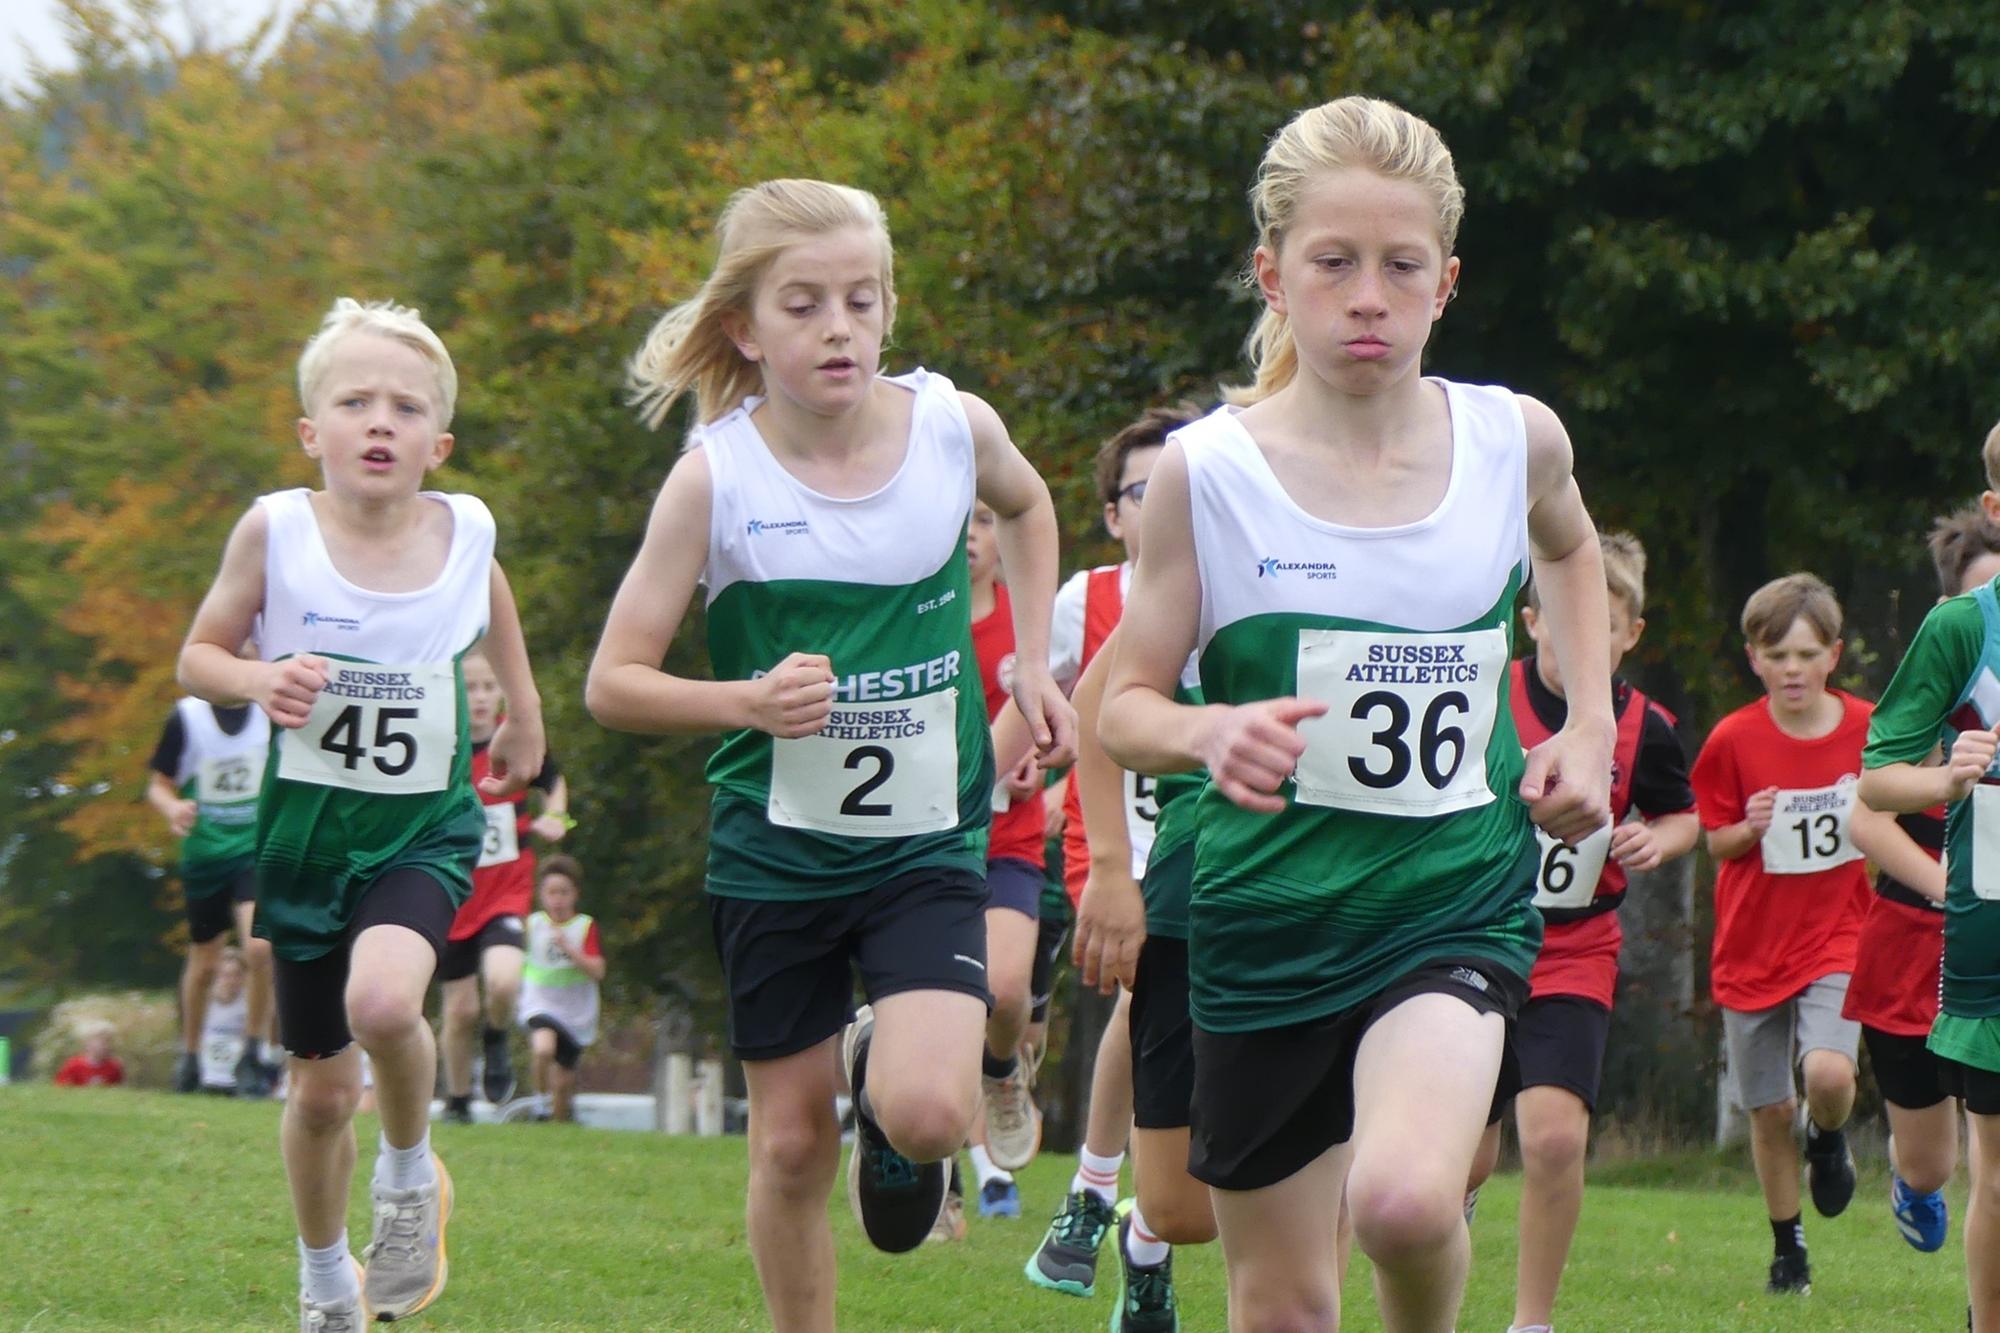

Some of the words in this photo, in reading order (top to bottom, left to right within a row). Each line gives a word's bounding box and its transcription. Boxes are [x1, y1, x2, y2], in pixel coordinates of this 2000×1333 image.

[761, 521, 807, 529] ALEXANDRA
[1276, 562, 1336, 570] ALEXANDRA
[1307, 572, 1337, 580] SPORTS
[917, 599, 938, 614] EST.
[1368, 644, 1465, 664] SUSSEX
[338, 670, 412, 687] SUSSEX
[1346, 663, 1478, 684] ATHLETICS
[322, 682, 425, 700] ATHLETICS
[830, 708, 912, 725] SUSSEX
[320, 704, 419, 777] 45
[1347, 690, 1470, 790] 36
[840, 745, 894, 816] 2
[1792, 814, 1840, 859] 13
